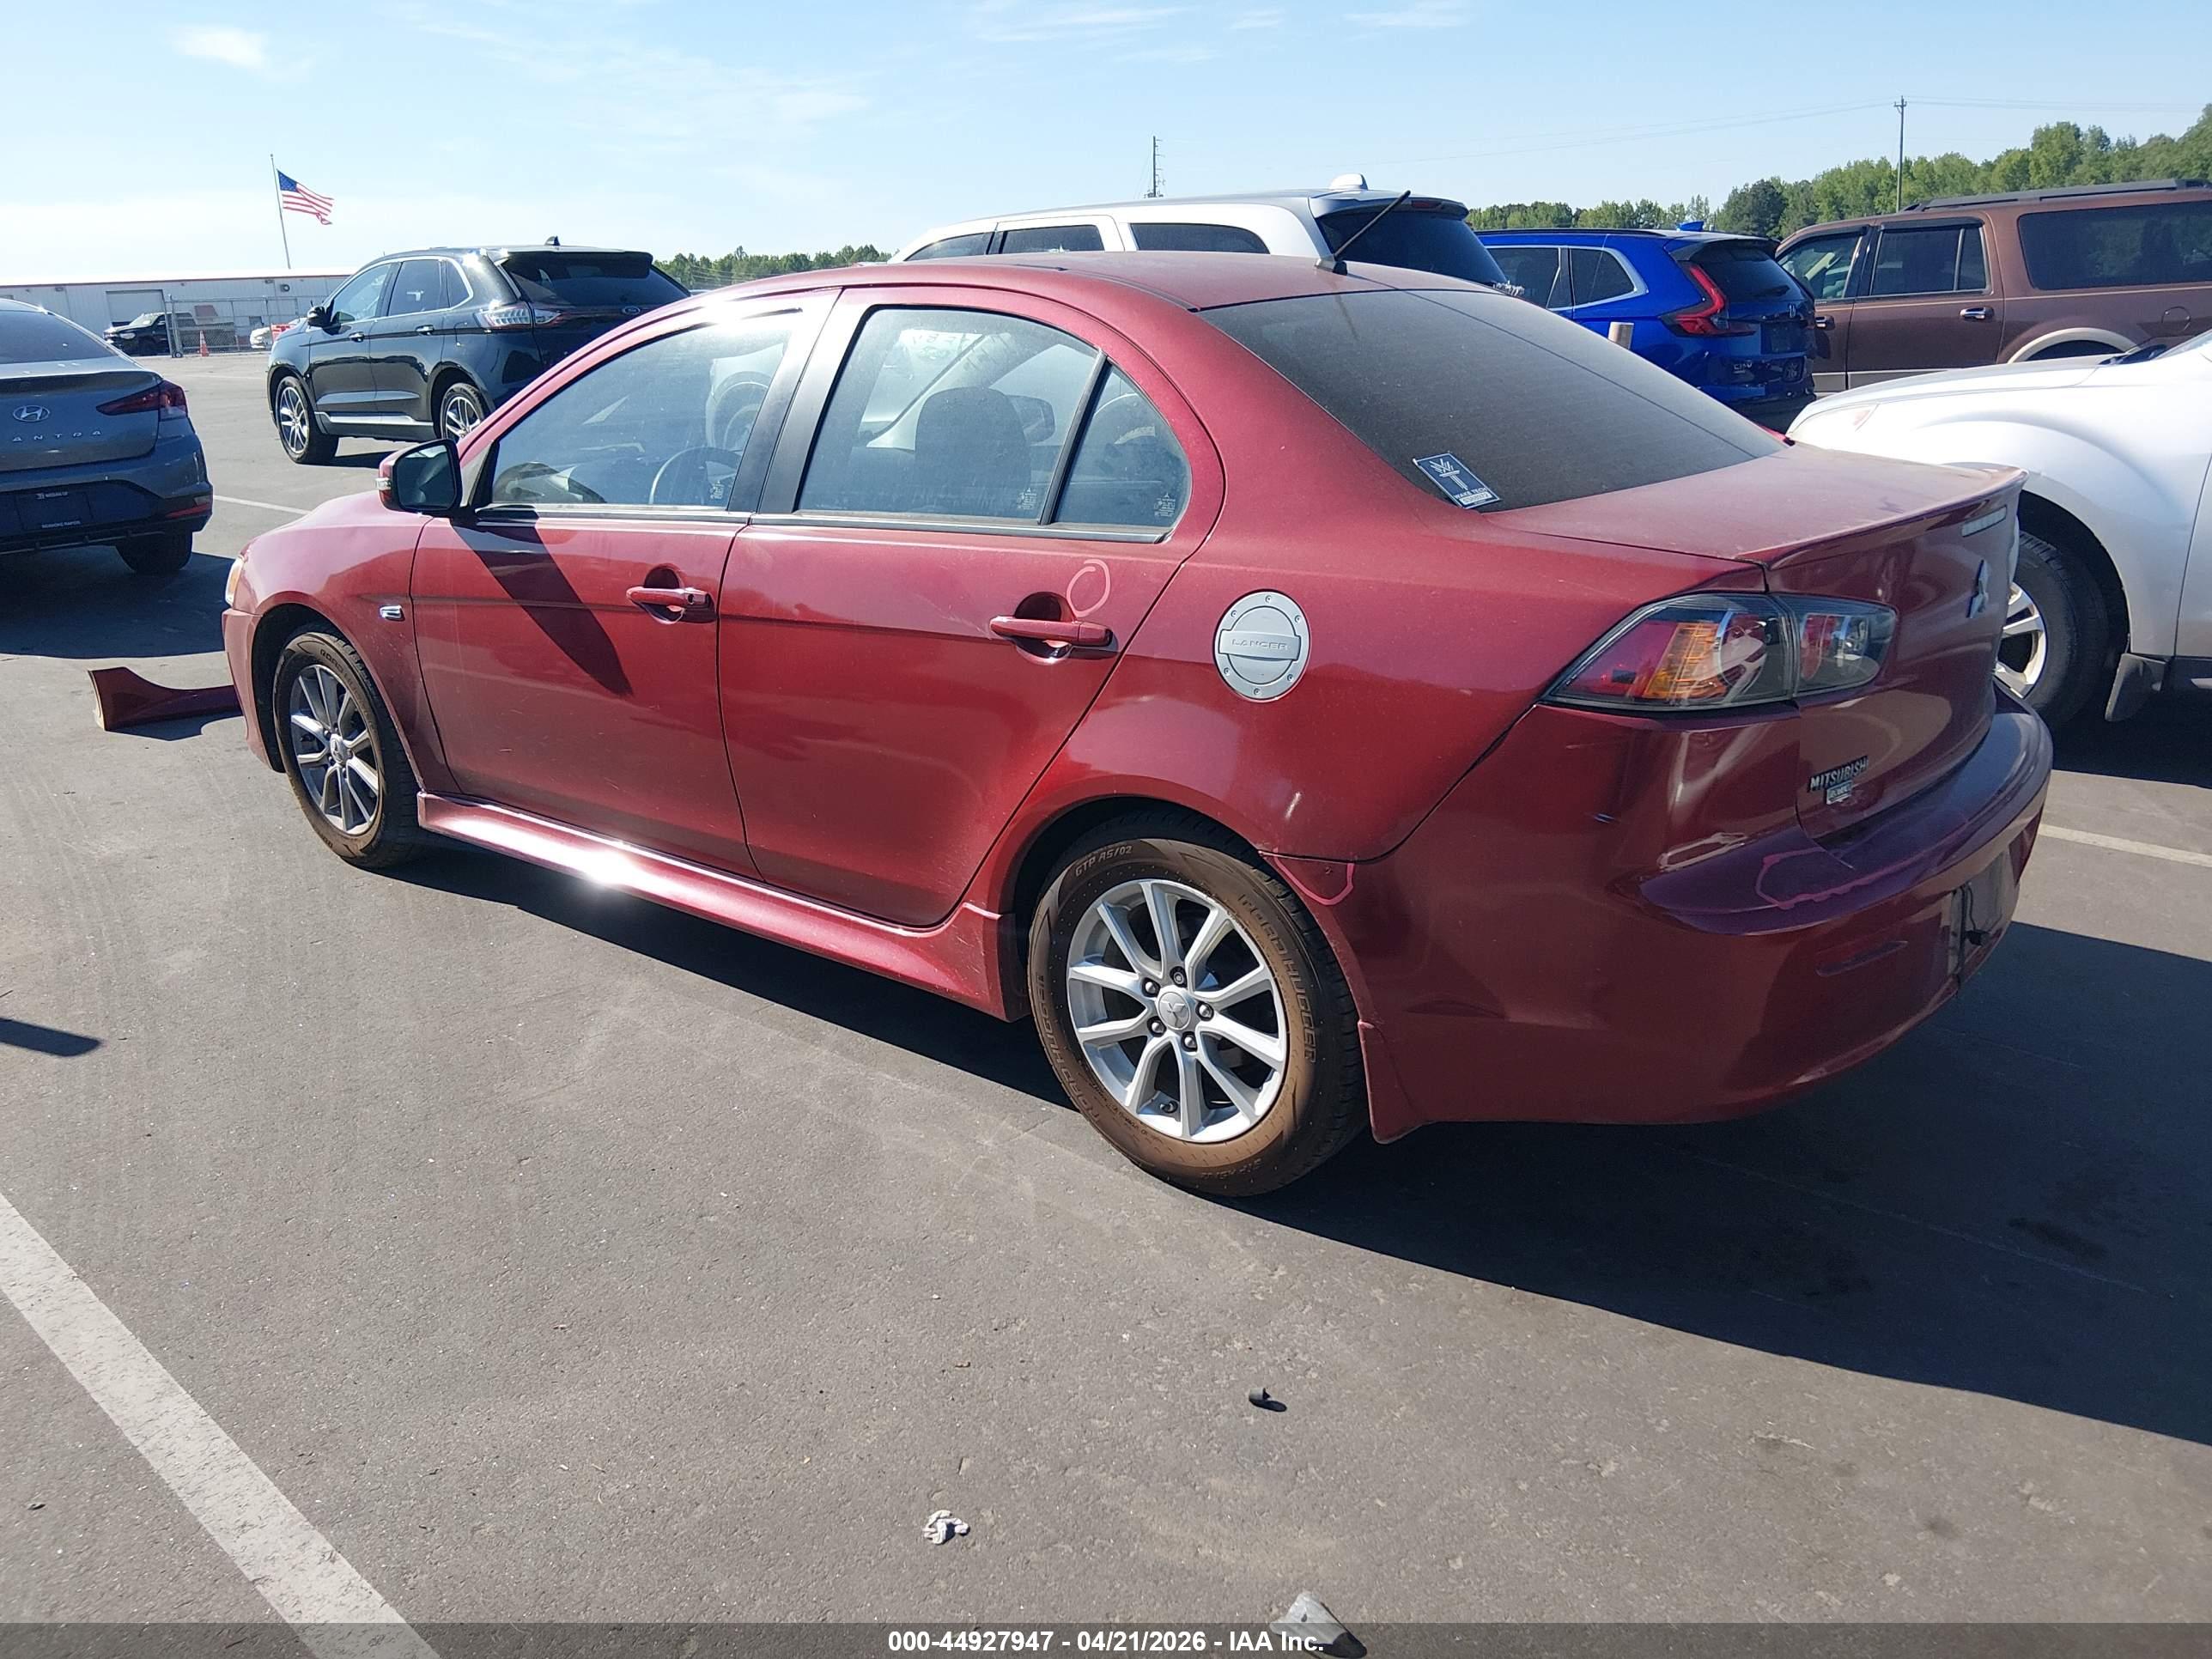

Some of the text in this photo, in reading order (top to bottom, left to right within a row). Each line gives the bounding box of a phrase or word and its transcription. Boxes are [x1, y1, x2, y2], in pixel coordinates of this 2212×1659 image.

[1454, 490, 1472, 499] WAKE
[1231, 638, 1288, 650] LANCER
[1075, 845, 1133, 877] GTP AS/02
[1281, 957, 1317, 1063] HUGGER
